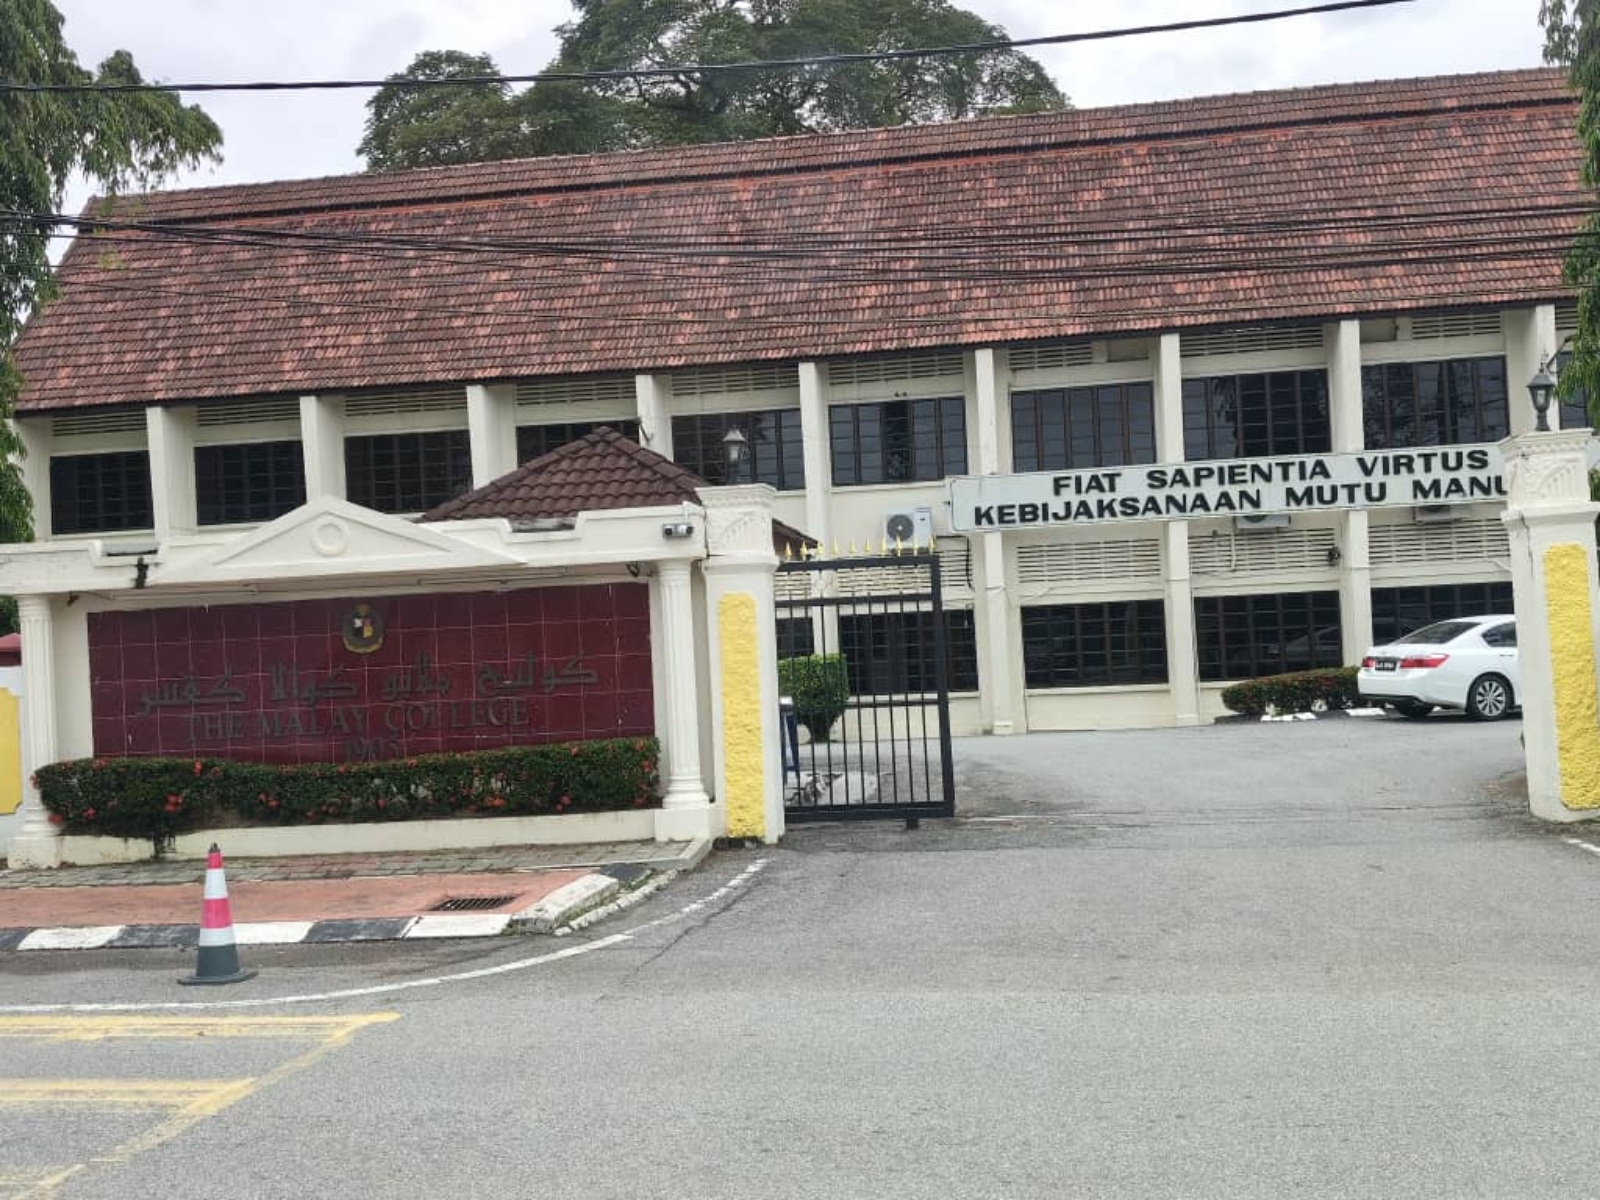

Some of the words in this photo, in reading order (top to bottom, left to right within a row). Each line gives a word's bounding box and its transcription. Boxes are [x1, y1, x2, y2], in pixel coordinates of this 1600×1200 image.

[1053, 472, 1122, 496] FIAT
[1147, 459, 1331, 490] SAPIENTIA
[1356, 449, 1490, 478] VIRTUS
[974, 491, 1261, 526] KEBIJAKSANAAN
[1285, 482, 1387, 507] MUTU
[186, 711, 245, 742] THE
[258, 707, 367, 738] MALAY
[384, 696, 530, 731] COLLEGE
